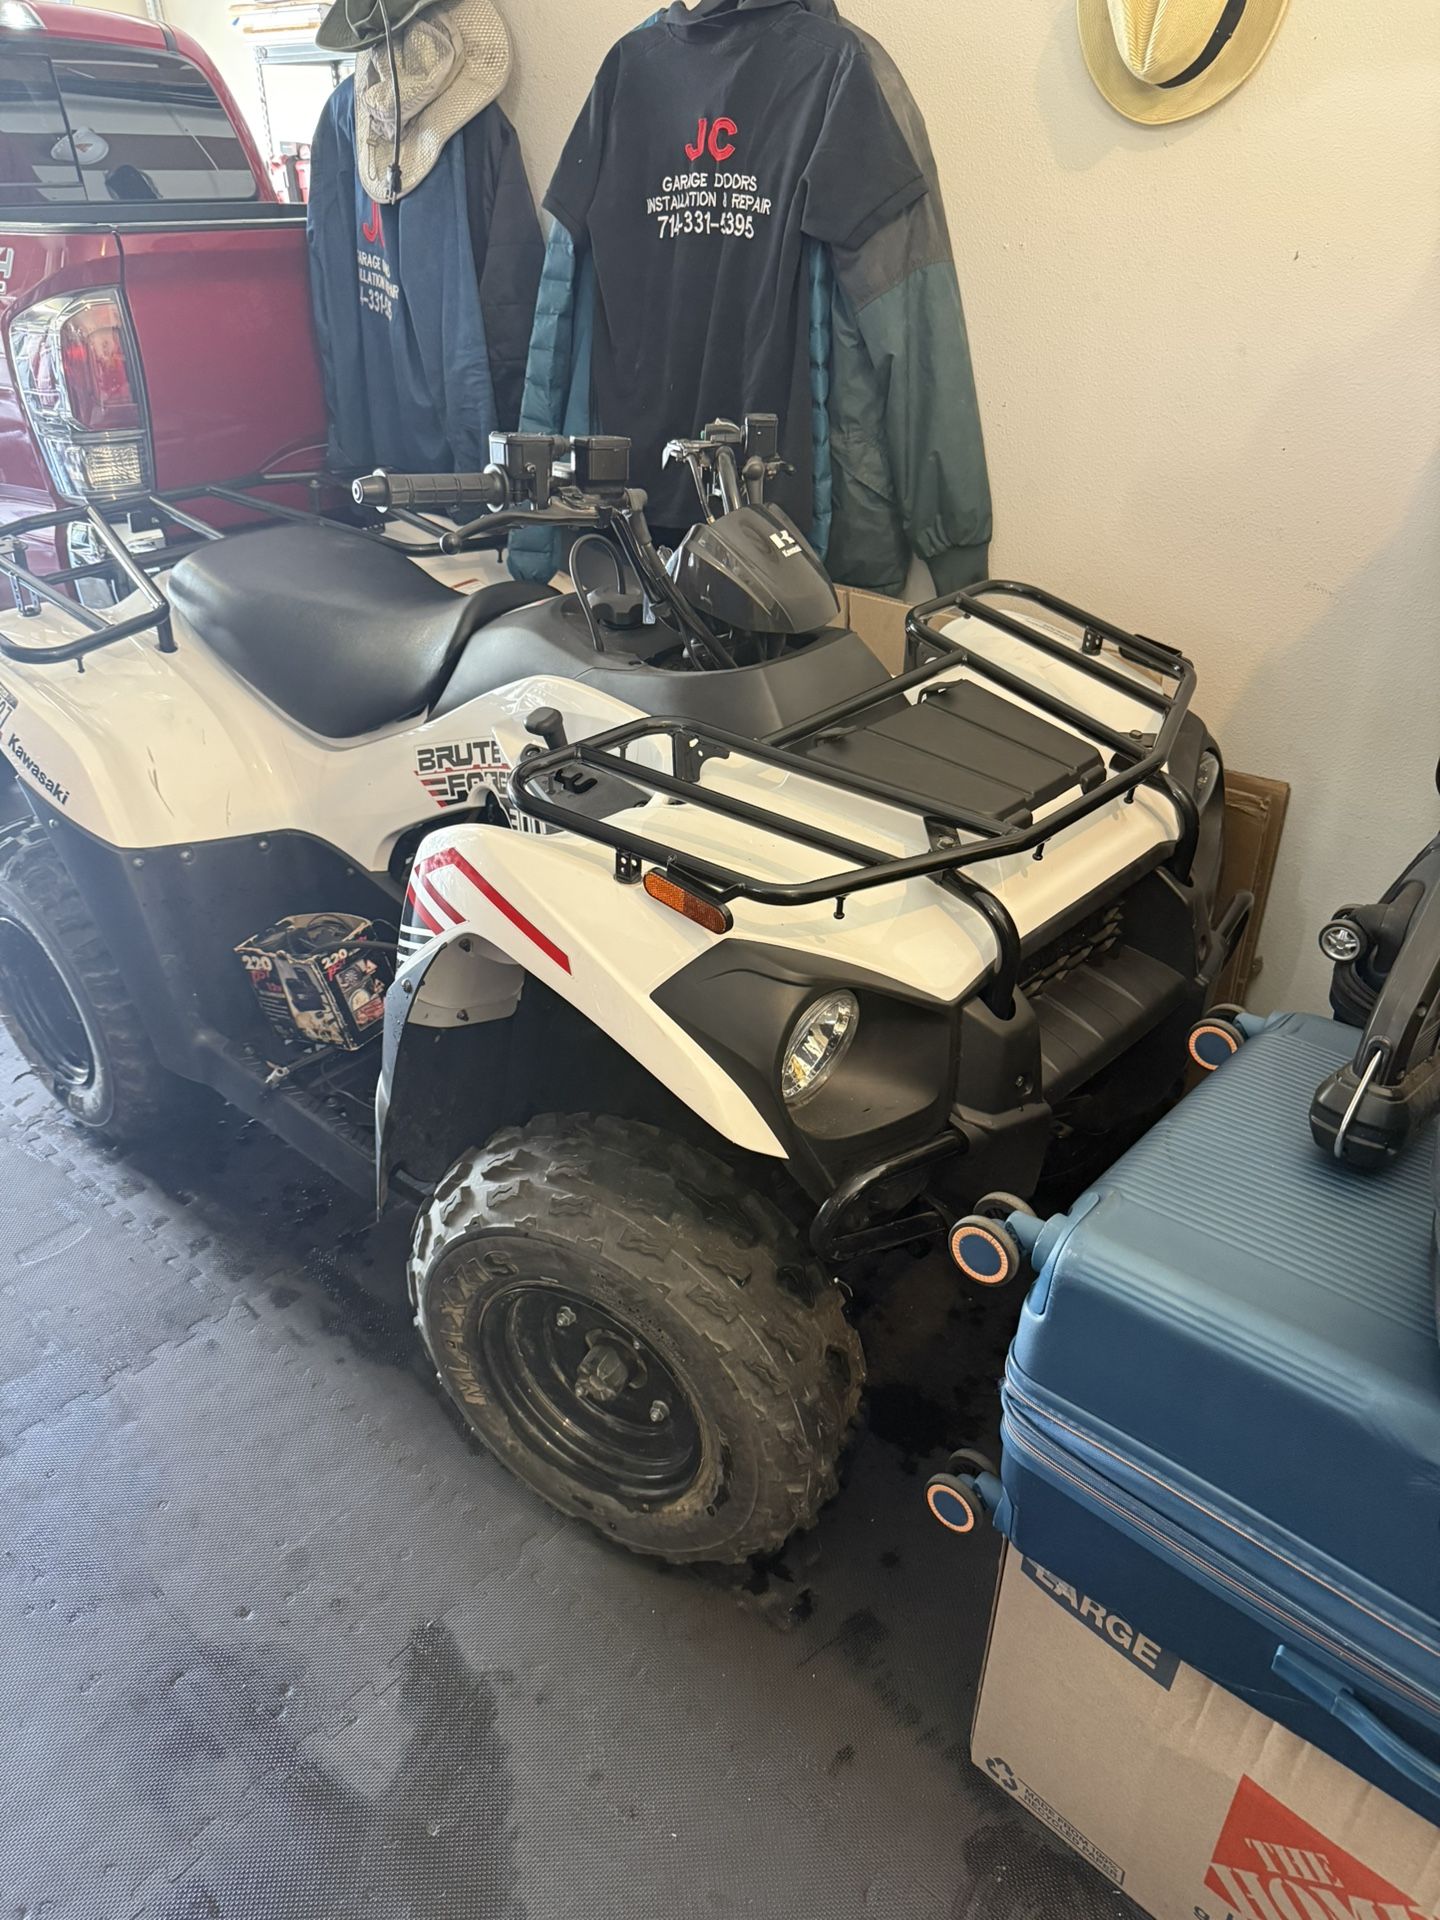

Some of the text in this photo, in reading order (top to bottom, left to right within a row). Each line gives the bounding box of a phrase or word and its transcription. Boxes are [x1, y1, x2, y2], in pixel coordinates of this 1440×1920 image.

[685, 117, 737, 161] JC
[662, 172, 757, 192] GARAGE DOORS
[731, 193, 772, 215] REPAIR
[8, 733, 70, 805] Kawasaki
[417, 740, 501, 772] BRUTE
[241, 955, 272, 972] 220
[1023, 1794, 1118, 1878] RECYCLED PAPER
[1024, 1787, 1056, 1817] MADE
[1057, 1817, 1089, 1847] FROM
[1244, 1837, 1344, 1888] THE
